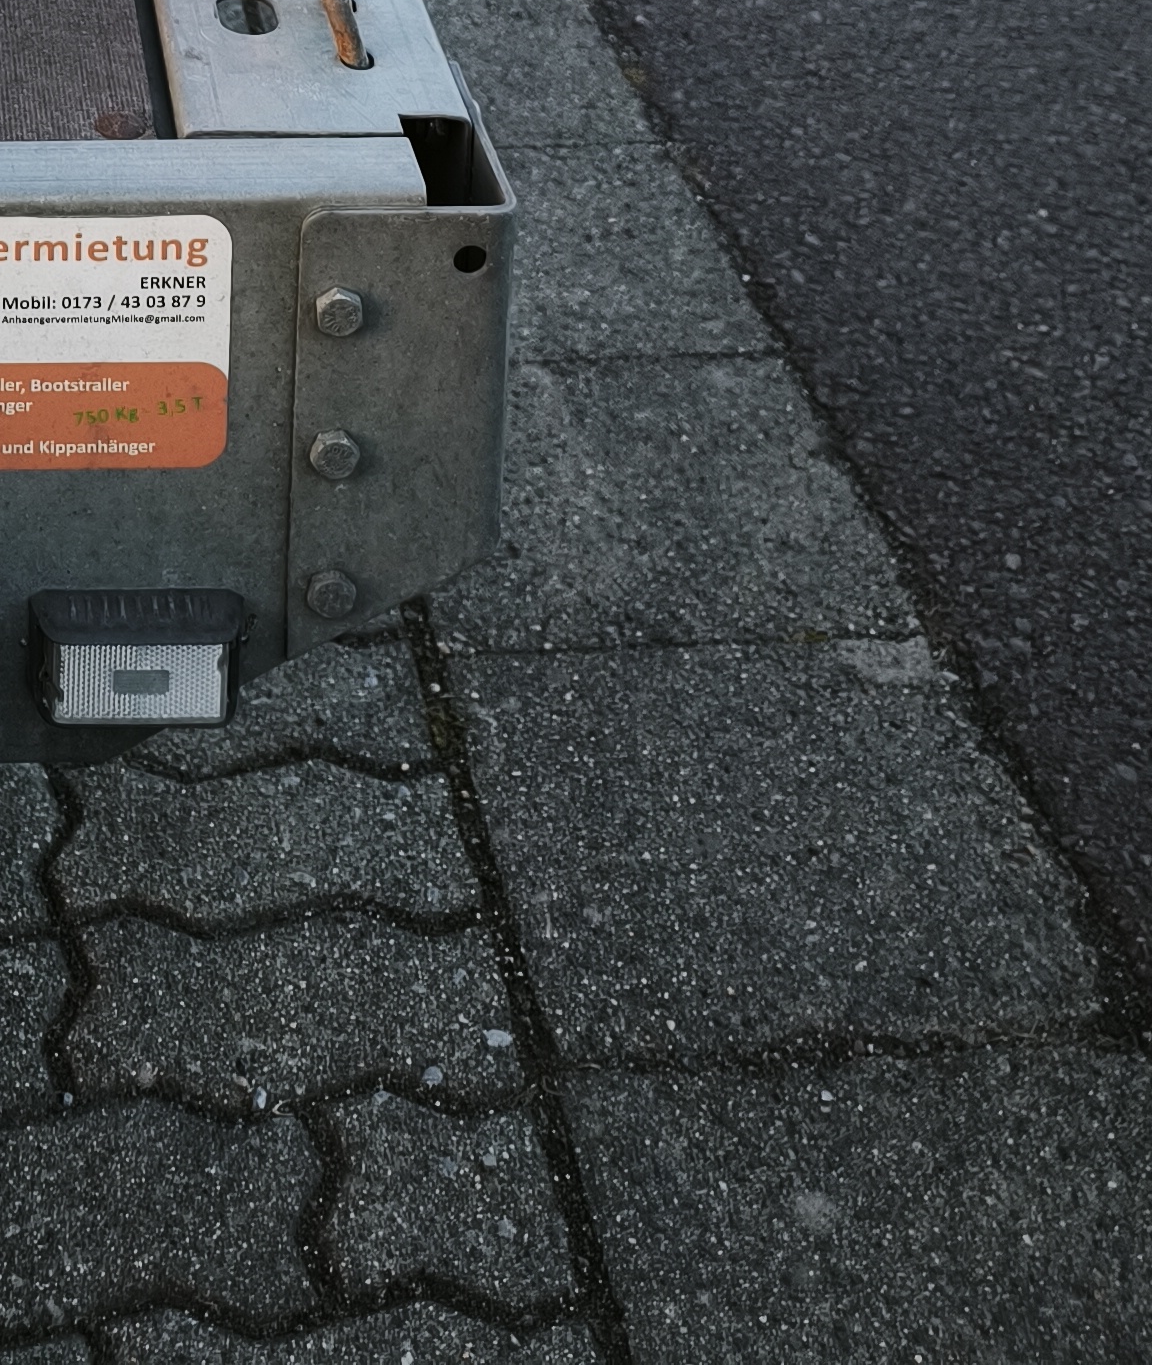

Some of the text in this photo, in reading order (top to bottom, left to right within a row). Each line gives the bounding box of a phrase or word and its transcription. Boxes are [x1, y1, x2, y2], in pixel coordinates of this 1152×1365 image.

[140, 276, 207, 290] ERKNER
[2, 294, 206, 311] Mobil: 0173 / 43 03 87 9
[30, 378, 129, 392] Bootstrailer
[73, 409, 109, 427] 750
[192, 396, 203, 411] T
[2, 441, 33, 455] und
[39, 440, 155, 457] Kippanhänger
